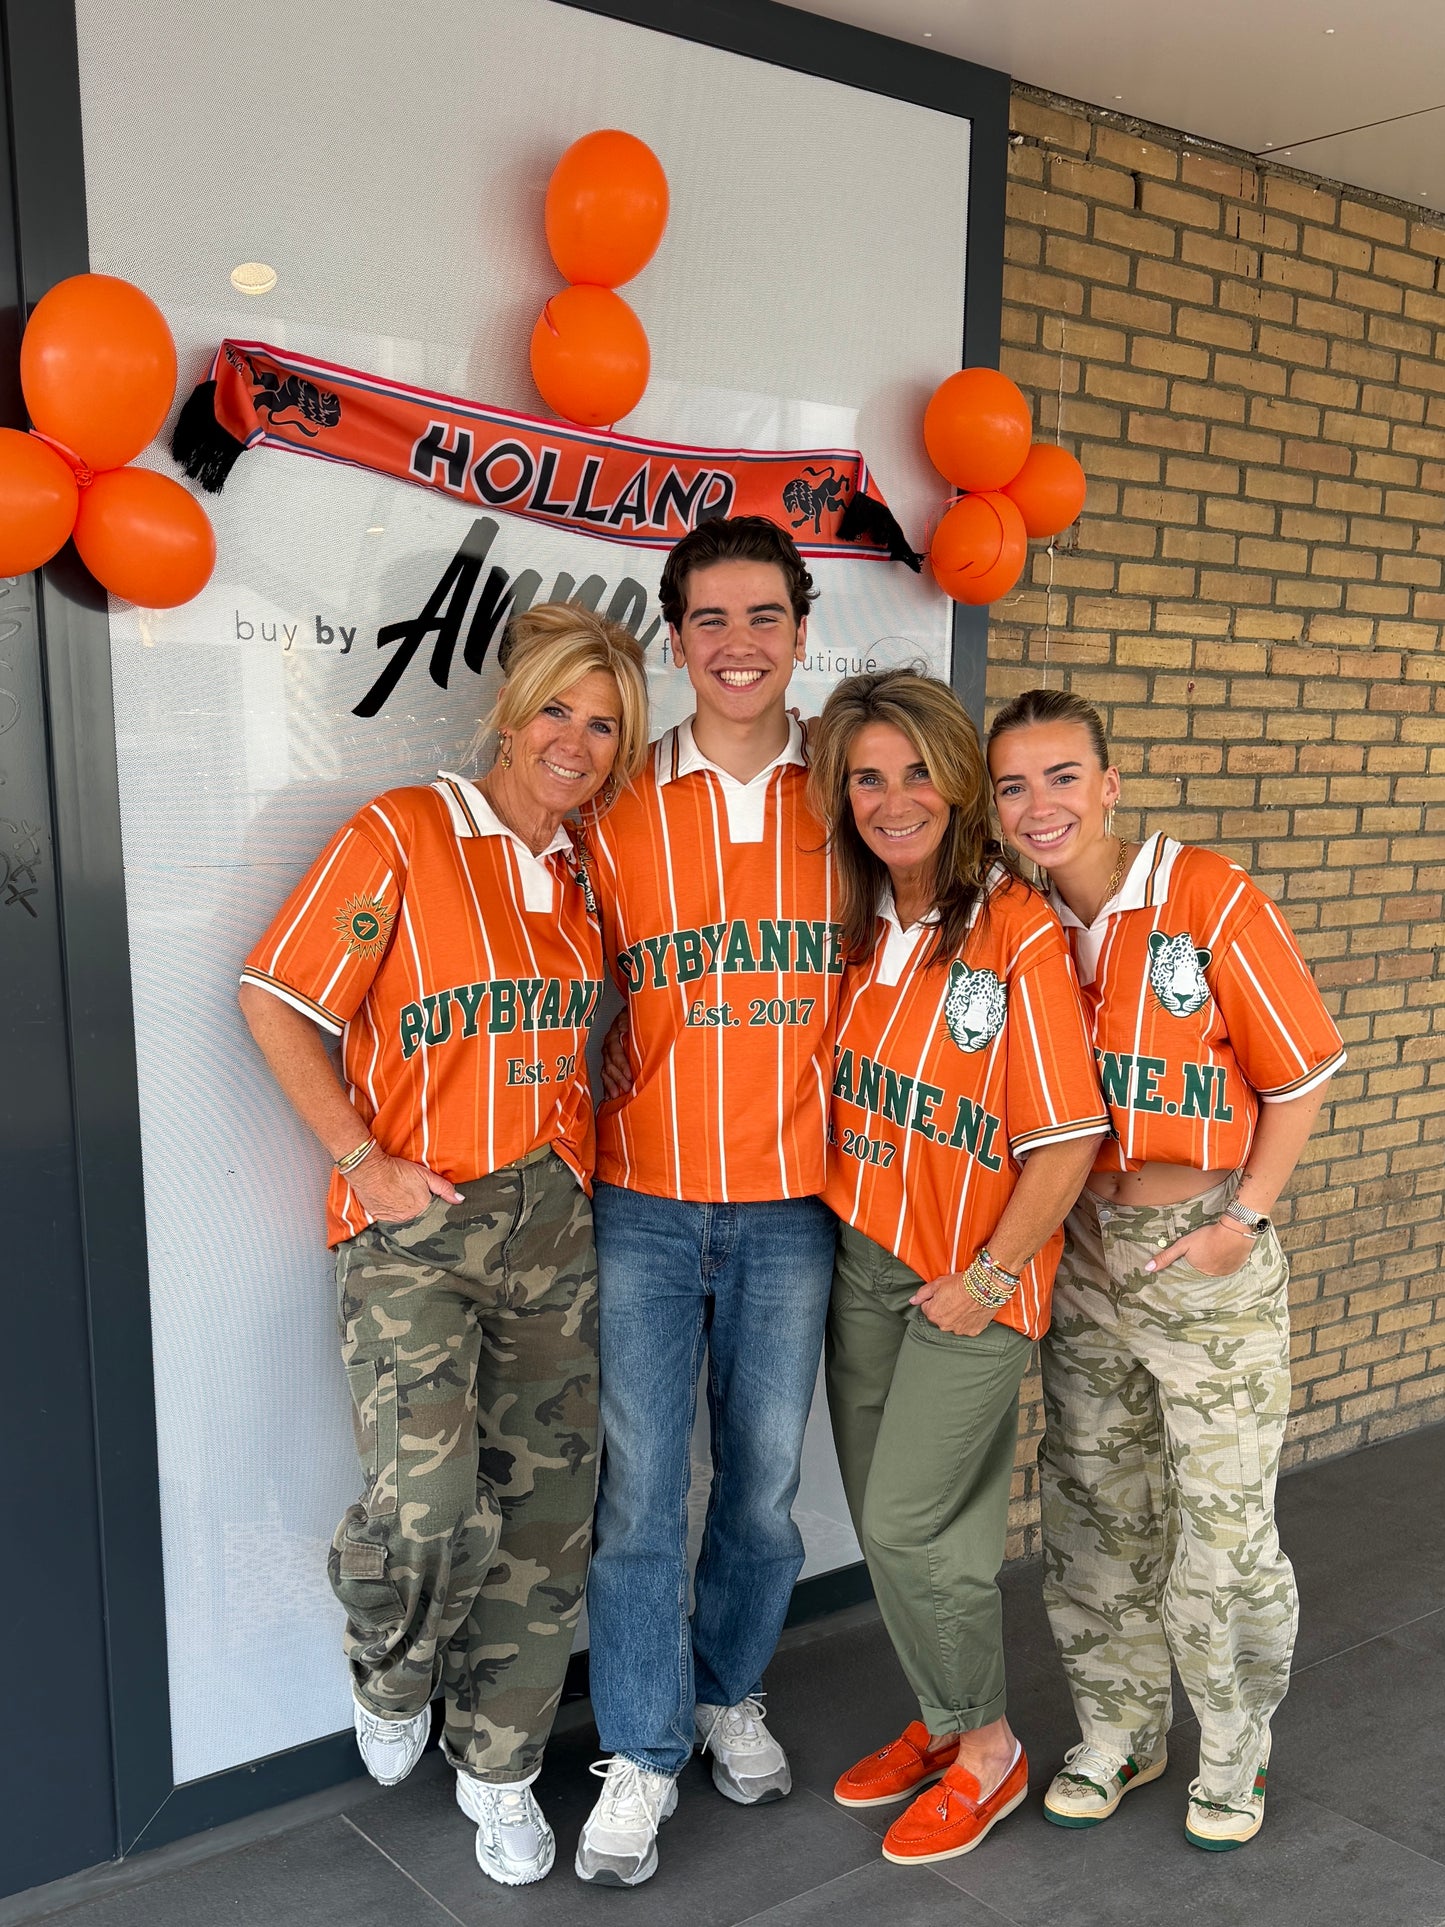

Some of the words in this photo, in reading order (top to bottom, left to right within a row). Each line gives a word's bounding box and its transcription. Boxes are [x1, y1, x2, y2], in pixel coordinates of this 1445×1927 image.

[409, 420, 736, 532] HOLLAND
[235, 611, 298, 650] buy
[316, 615, 357, 654] by
[792, 650, 877, 677] utique
[686, 999, 741, 1027] Est.
[749, 998, 816, 1027] 2017
[506, 1058, 550, 1087] Est.
[1095, 1046, 1234, 1124] NE.NL
[832, 1044, 1003, 1173] ANNE.NL
[842, 1128, 898, 1169] 2017
